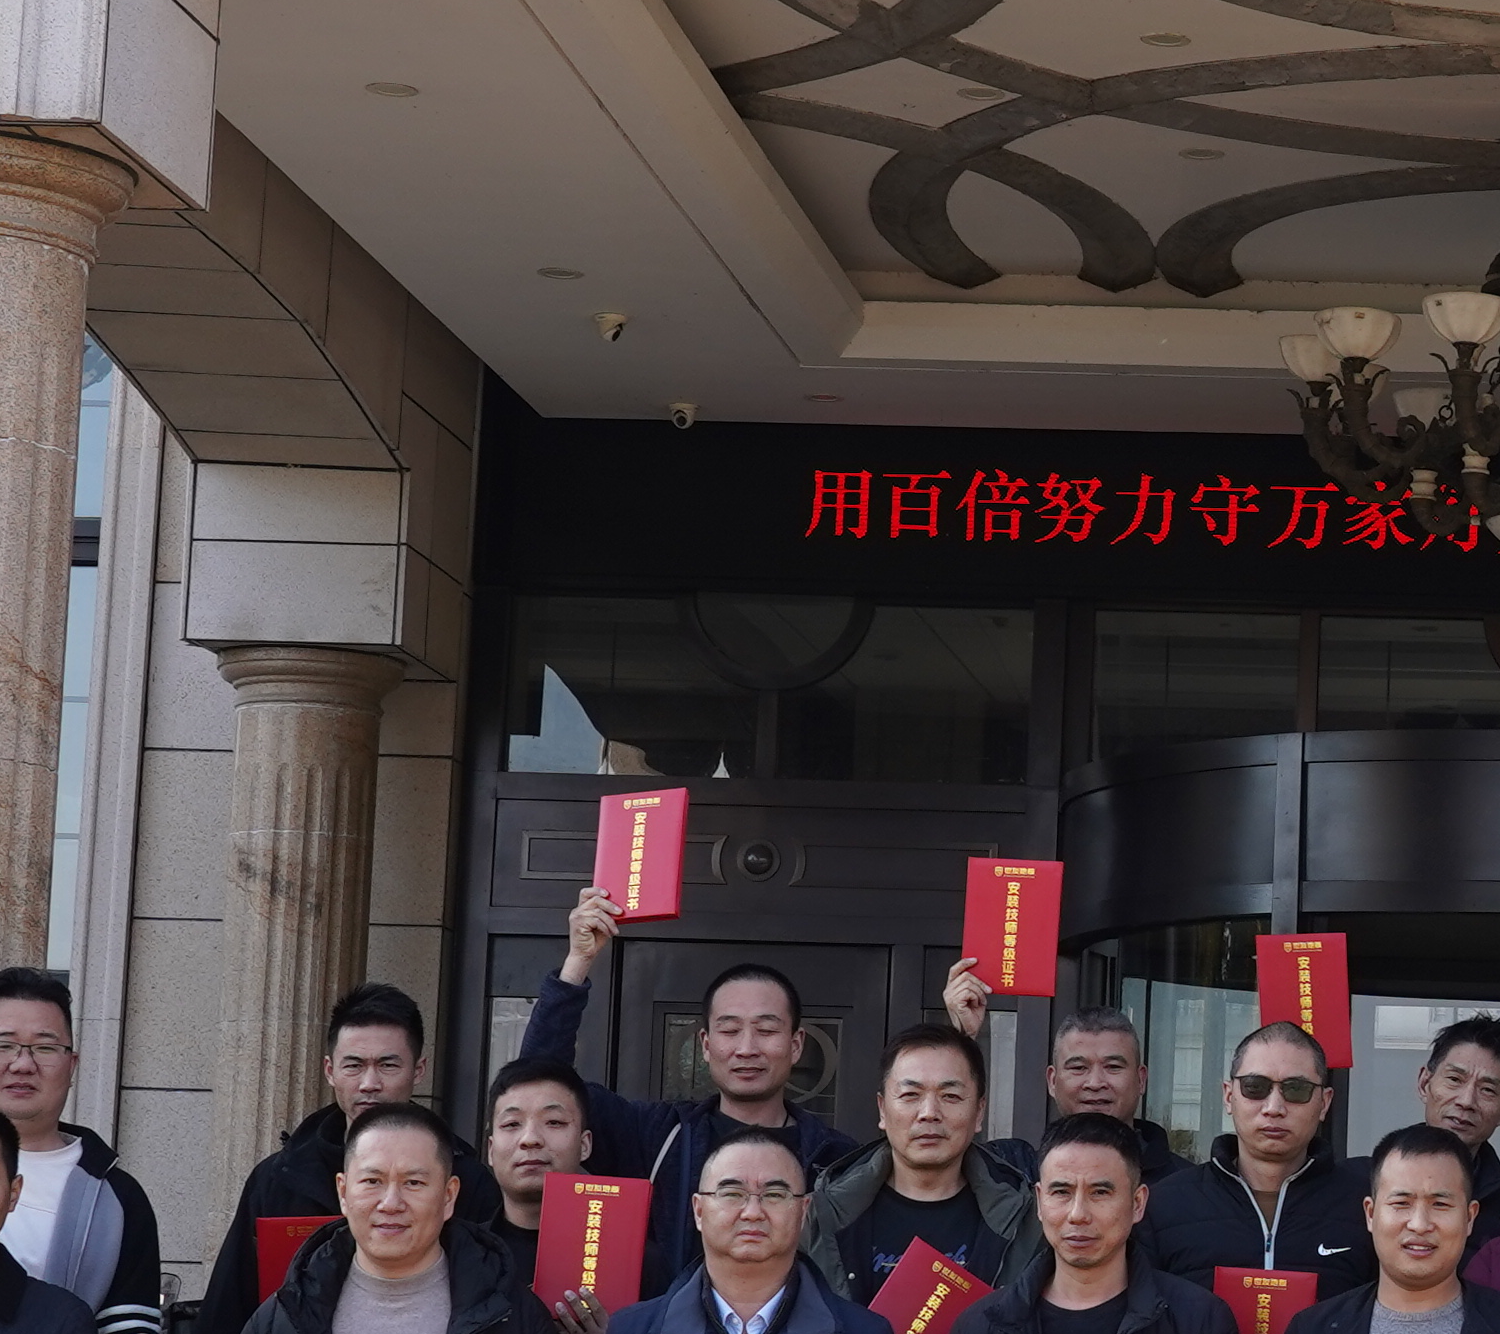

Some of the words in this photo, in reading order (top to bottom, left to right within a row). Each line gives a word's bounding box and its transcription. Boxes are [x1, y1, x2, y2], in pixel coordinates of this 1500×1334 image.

[625, 812, 647, 910] 安装技师等级证书
[1000, 881, 1021, 987] 安装技师等级证书
